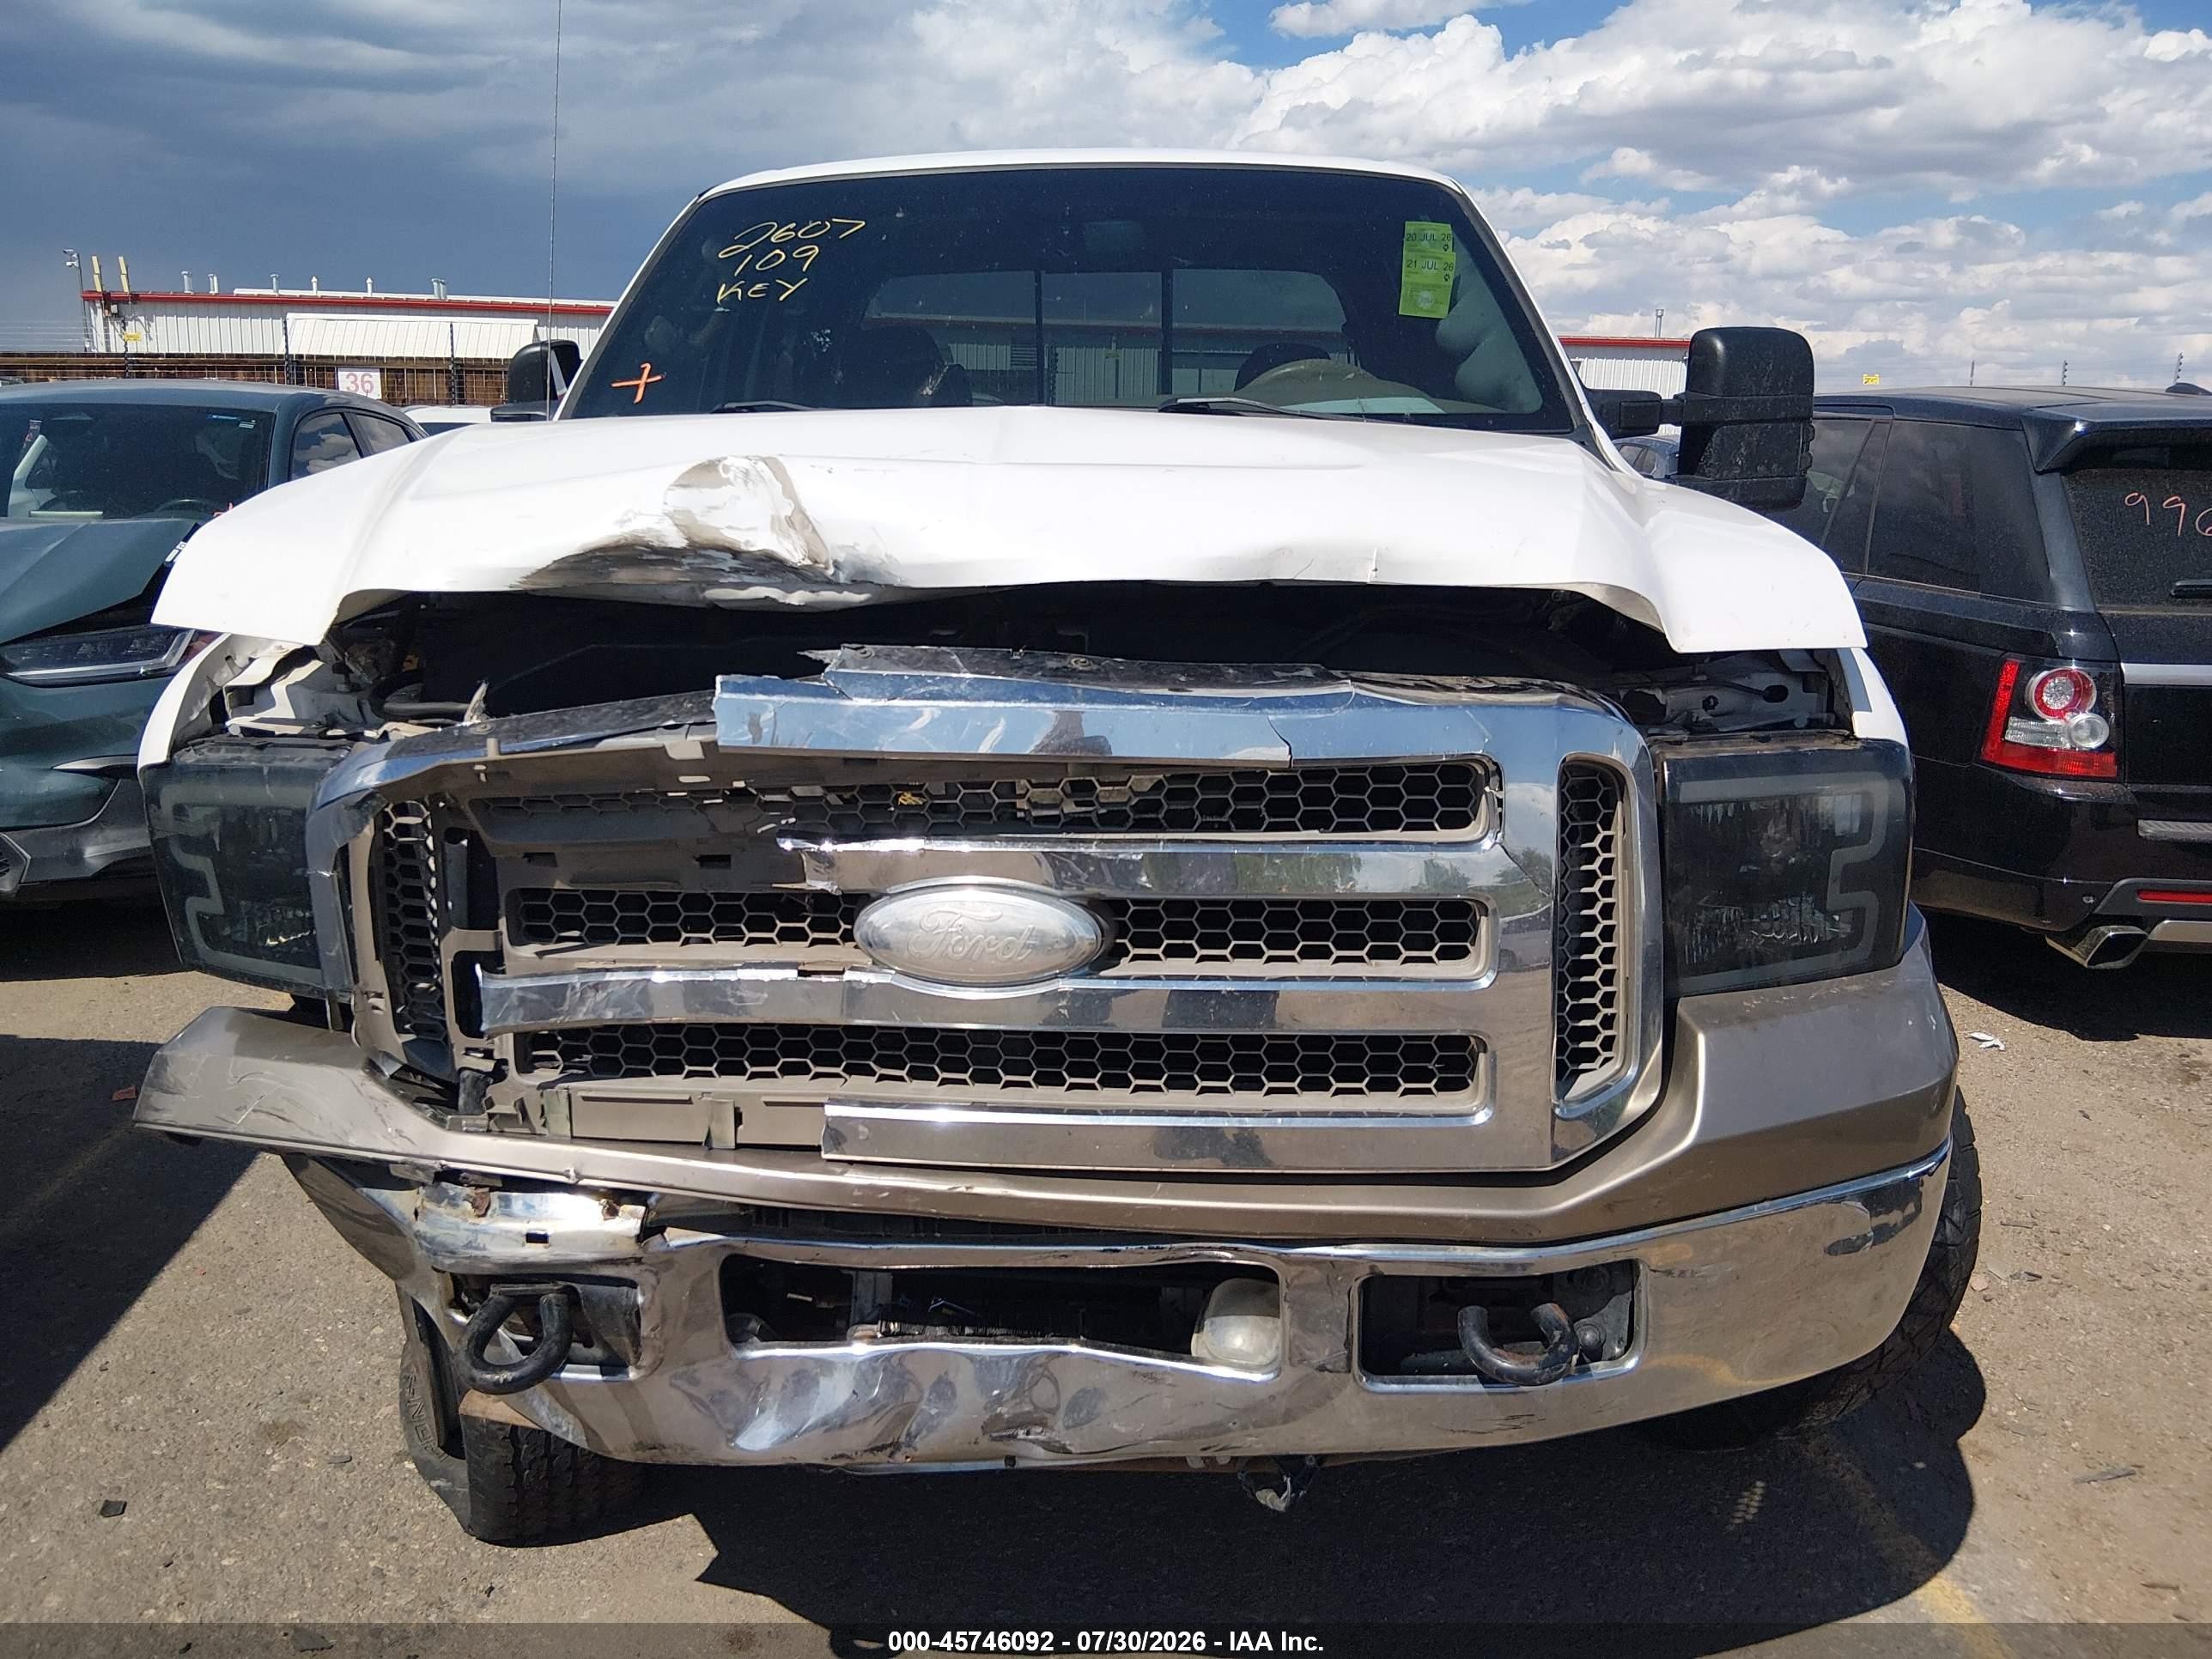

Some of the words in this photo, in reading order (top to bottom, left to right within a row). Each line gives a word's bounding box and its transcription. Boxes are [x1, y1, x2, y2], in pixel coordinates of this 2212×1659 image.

[718, 217, 866, 258] 2607
[1407, 233, 1417, 241] 20
[1421, 233, 1437, 241] JUL
[733, 245, 819, 277] 109
[1407, 259, 1417, 269] 21
[1421, 260, 1438, 270] JUL
[1443, 262, 1454, 271] 26
[716, 277, 808, 304] KEY
[346, 373, 374, 393] 36
[906, 906, 1037, 961] Ford
